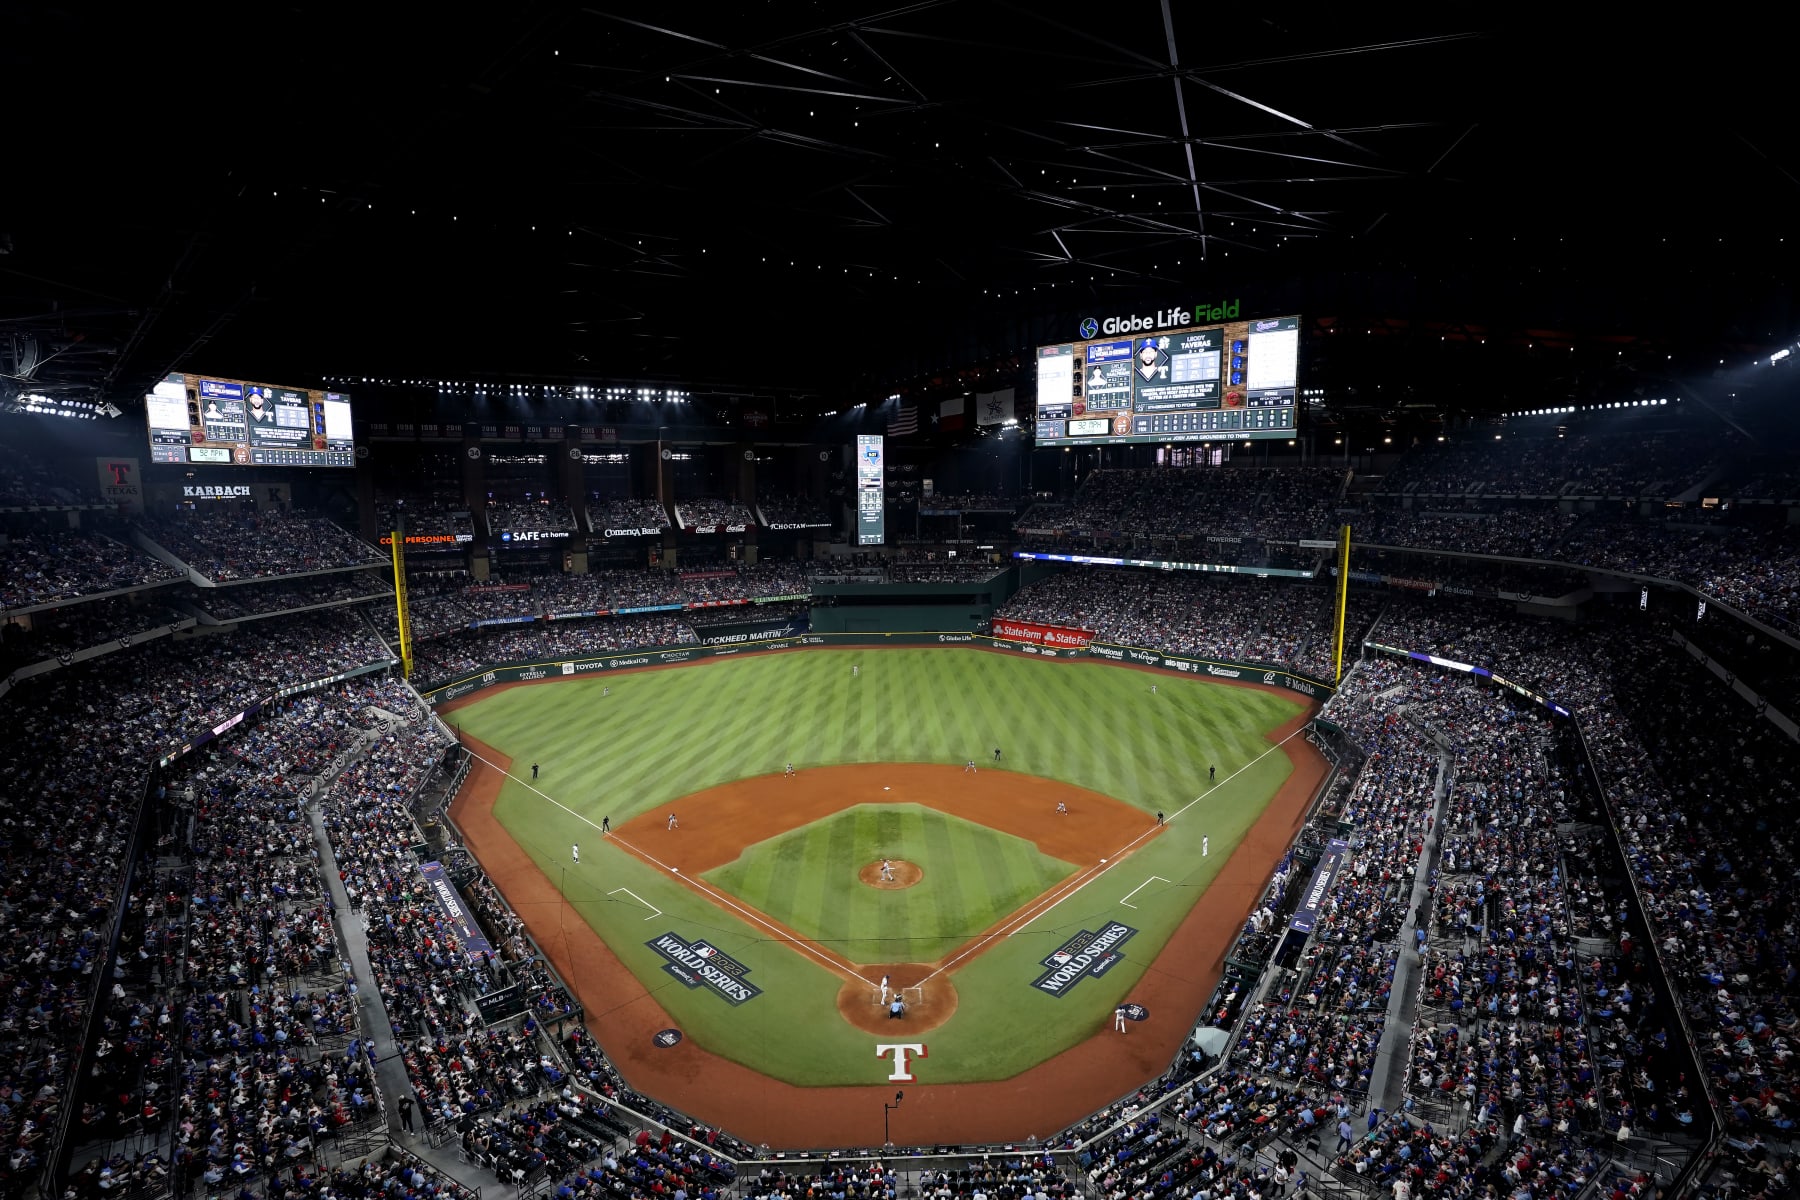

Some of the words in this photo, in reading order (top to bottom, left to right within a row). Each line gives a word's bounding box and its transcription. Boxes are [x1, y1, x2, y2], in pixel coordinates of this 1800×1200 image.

[1103, 315, 1153, 334] Globe
[1157, 307, 1191, 328] Life
[1195, 299, 1239, 323] Field
[1181, 340, 1211, 349] TAVERAS
[106, 487, 138, 495] TEXAS
[183, 486, 251, 496] KARBACH
[268, 487, 282, 502] K
[726, 524, 746, 532] Coca-Cola
[406, 536, 456, 544] PERSONNEL
[513, 532, 540, 540] SAFE
[702, 634, 747, 645] LOCKHEED
[750, 630, 781, 639] MARTIN
[1098, 648, 1123, 657] National
[1138, 652, 1159, 664] Kroger
[483, 672, 495, 682] UTA
[1292, 681, 1315, 694] Mobile
[1065, 934, 1094, 954] 2023
[1040, 954, 1092, 991] WORLD
[1084, 924, 1128, 957] SERIES
[656, 936, 705, 969] WORLD
[698, 966, 752, 1000] SERIES
[710, 955, 742, 976] 2023
[489, 995, 503, 1005] MLB
[876, 1044, 928, 1084] T
